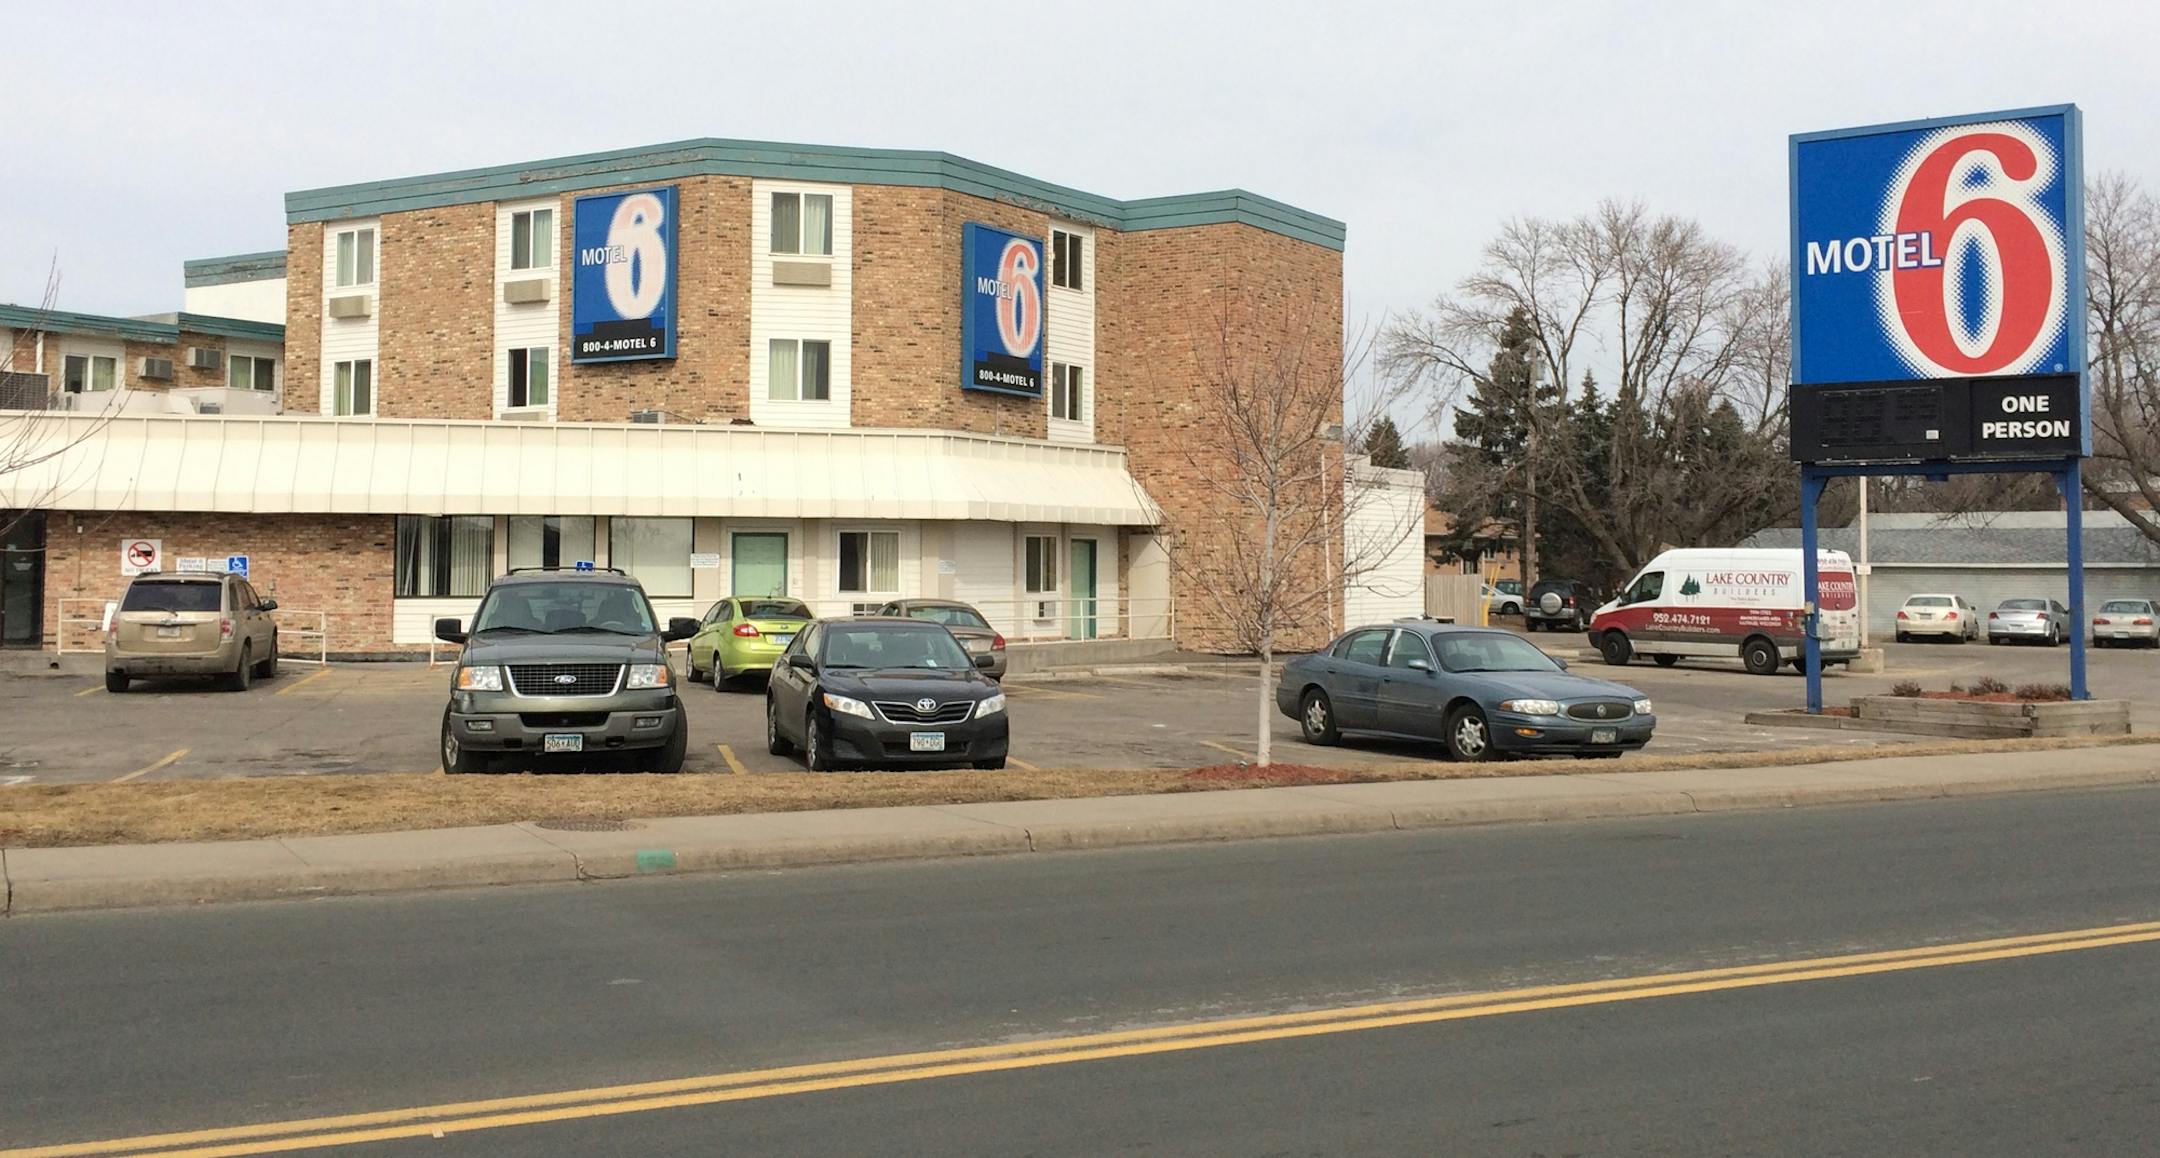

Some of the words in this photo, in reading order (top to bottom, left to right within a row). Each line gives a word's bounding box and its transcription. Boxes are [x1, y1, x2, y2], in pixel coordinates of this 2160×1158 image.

[582, 245, 628, 266] MOTEL
[606, 194, 666, 320] 6
[1807, 231, 1943, 275] MOTEL
[1892, 132, 2053, 375] 6
[977, 276, 1013, 301] MOTEL
[1000, 243, 1038, 352] 6
[582, 338, 647, 353] 800-4-MOTEL
[649, 337, 657, 348] 6
[979, 369, 1028, 387] 800-4-MOTEL
[1029, 377, 1035, 388] 6
[2001, 395, 2051, 414] ONE
[1982, 420, 2071, 440] PERSON
[1706, 573, 1733, 584] LAKE
[1735, 573, 1791, 586] COUNTRY
[1818, 581, 1830, 591] AKE
[1653, 613, 1711, 625] 952.474.7121
